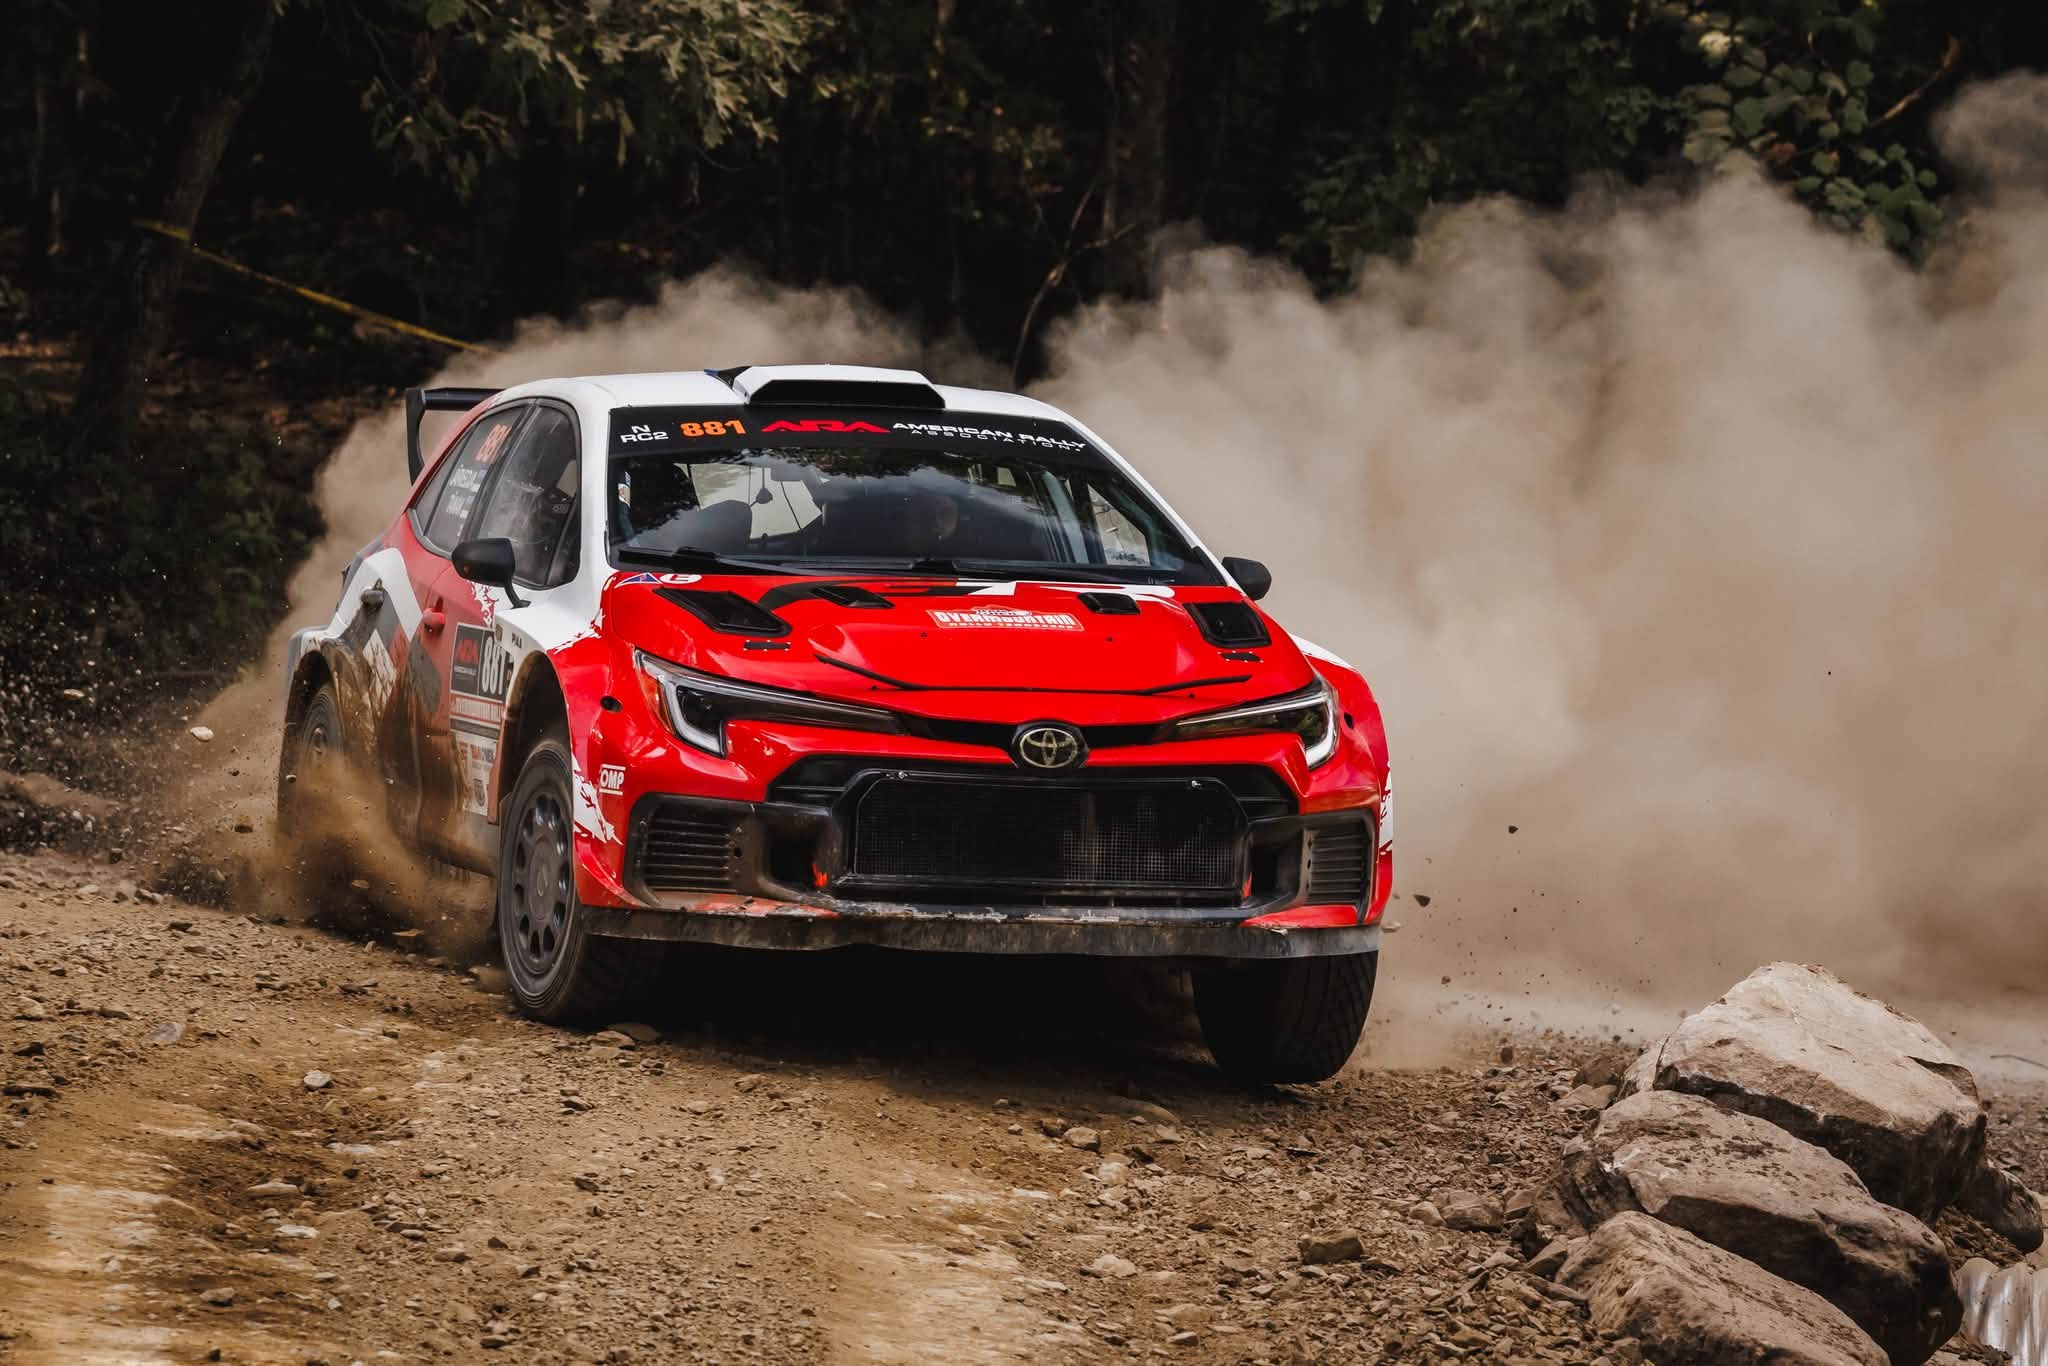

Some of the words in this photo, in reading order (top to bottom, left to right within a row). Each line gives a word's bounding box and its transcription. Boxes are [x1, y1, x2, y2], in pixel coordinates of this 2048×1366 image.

[632, 425, 650, 433] N
[680, 420, 746, 437] 881
[760, 419, 892, 433] ARA
[620, 431, 669, 443] RC2
[893, 423, 1013, 439] AMERICAN
[1018, 433, 1086, 449] RALLY
[600, 769, 624, 789] OMP
